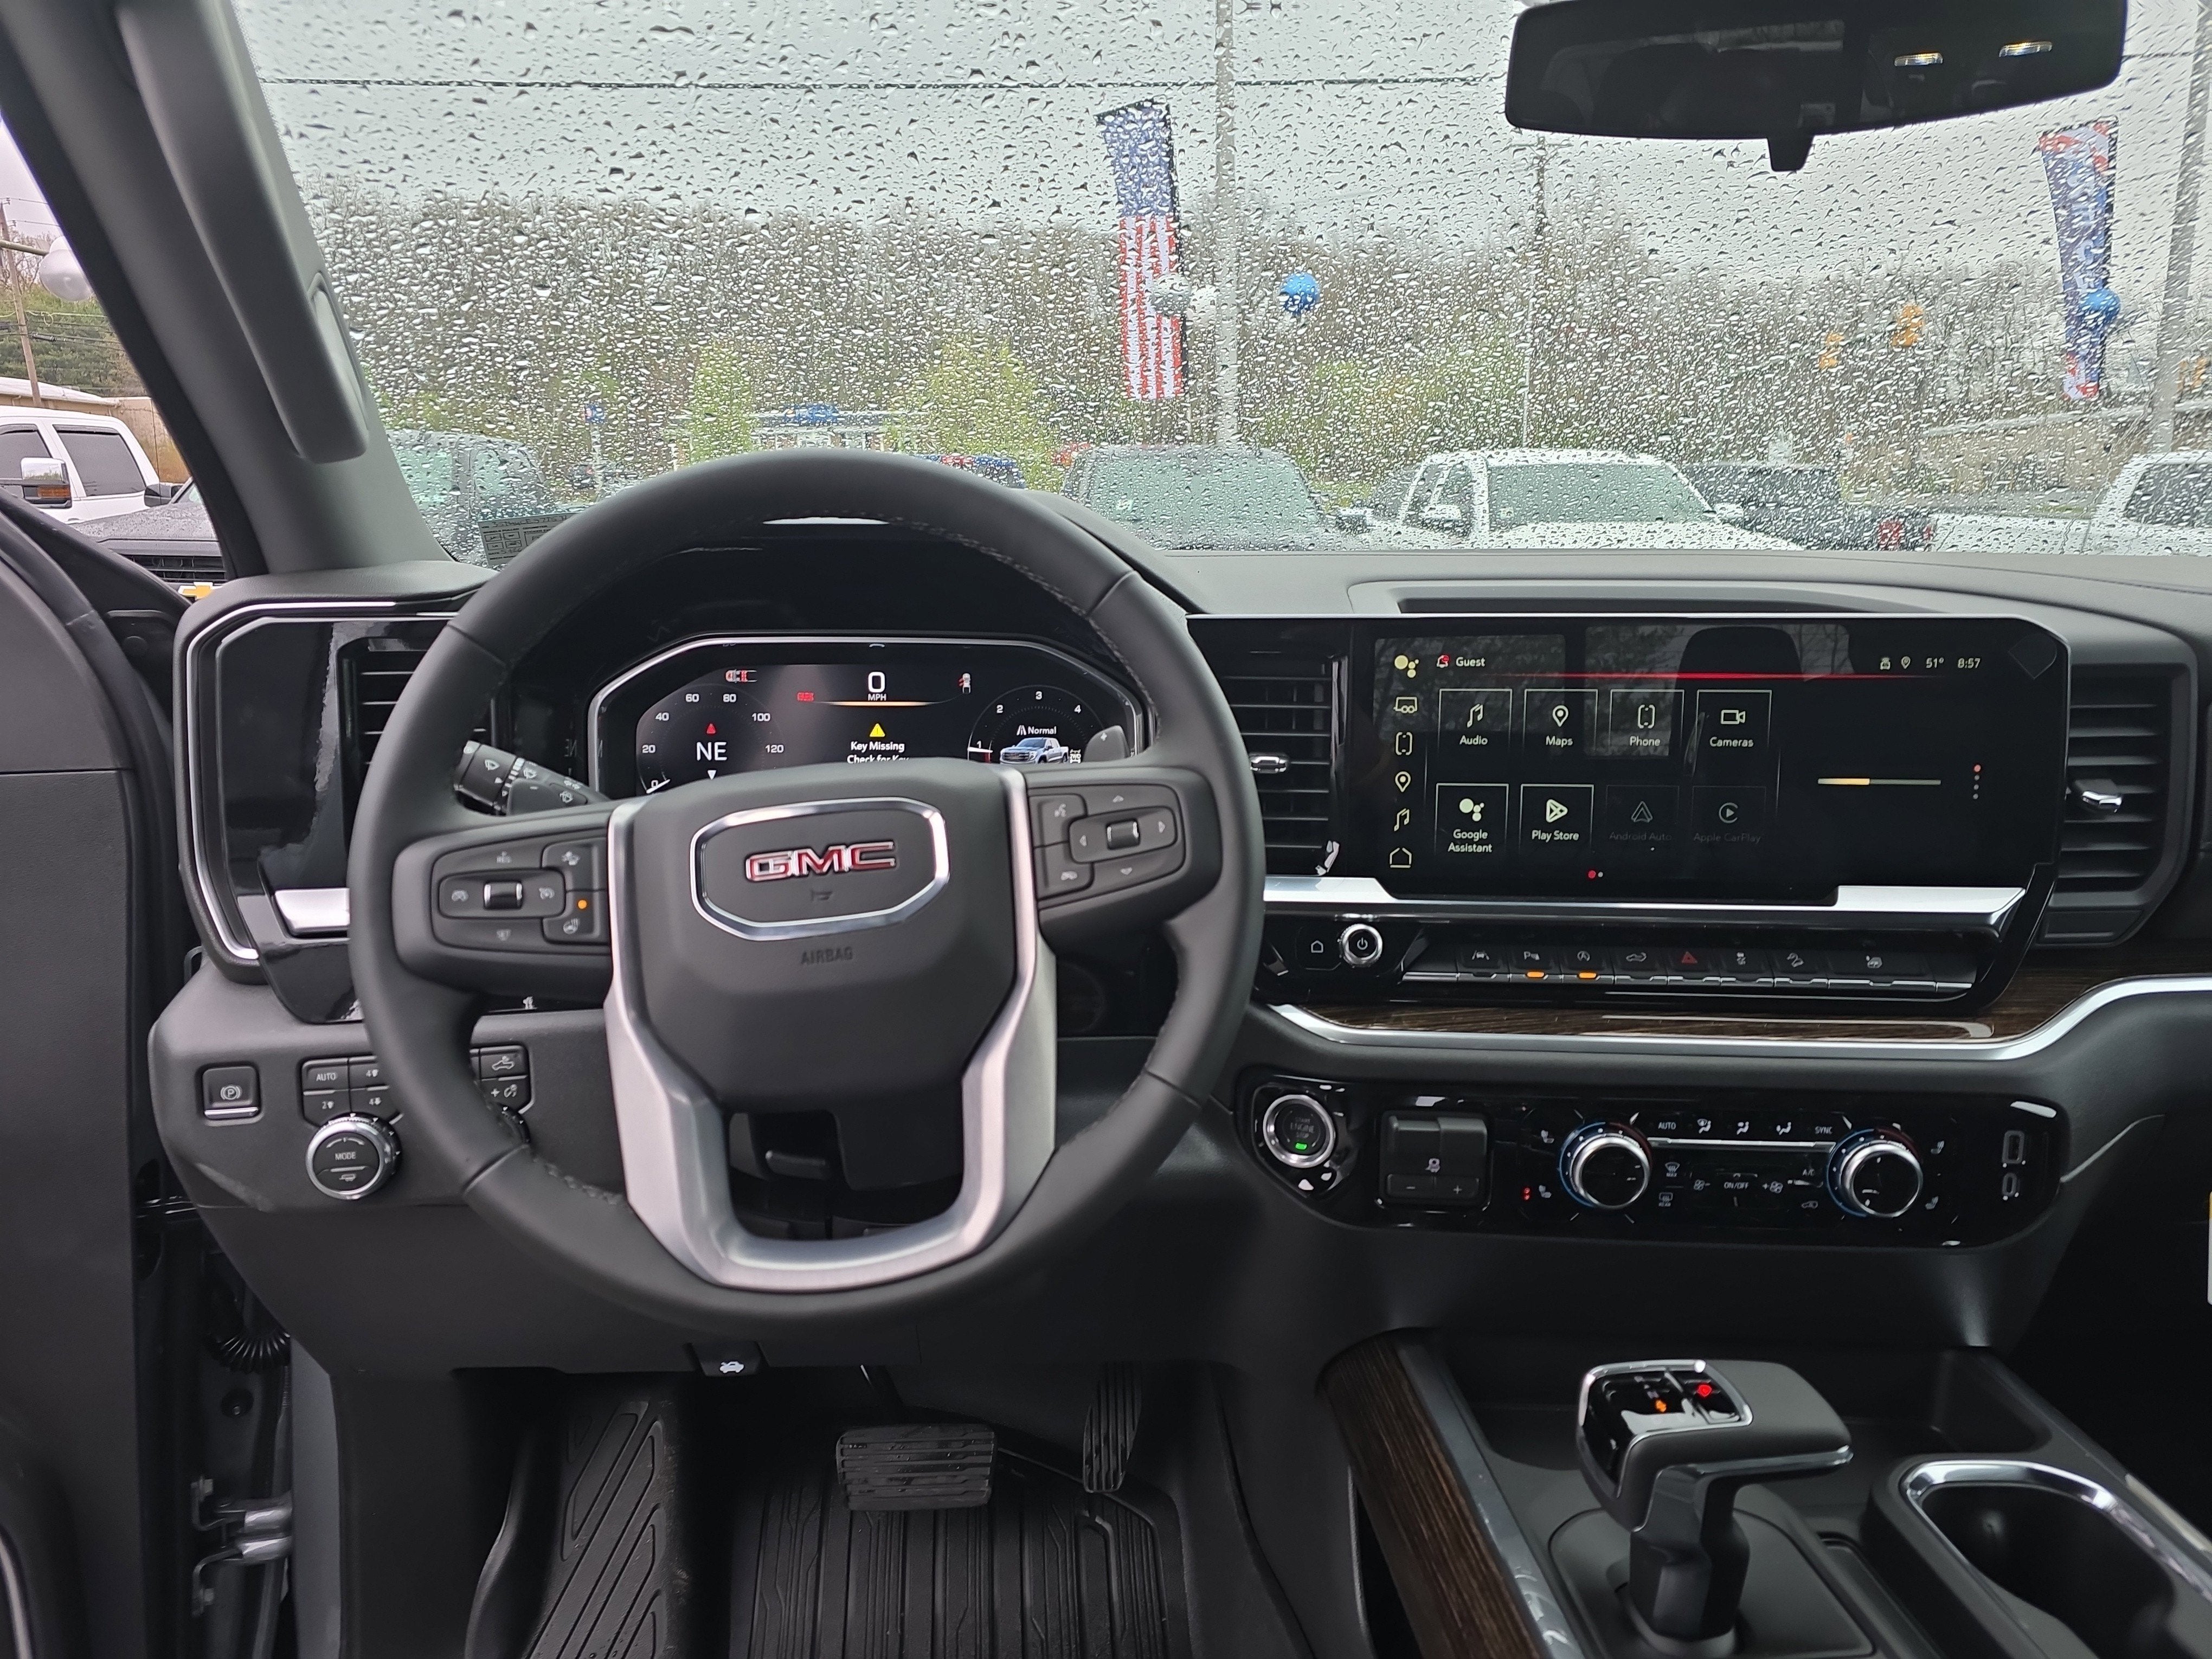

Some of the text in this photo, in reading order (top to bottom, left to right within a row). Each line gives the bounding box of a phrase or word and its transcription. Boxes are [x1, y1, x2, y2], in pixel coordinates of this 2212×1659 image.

[1456, 657, 1486, 667] Guest
[1957, 658, 1981, 668] 8:57
[867, 671, 885, 693] 0
[685, 693, 699, 703] 60
[723, 693, 737, 703] 80
[1036, 691, 1043, 700] 3
[996, 704, 1004, 713] 2
[1074, 705, 1082, 713] 4
[655, 712, 670, 721] 40
[752, 712, 771, 722] 100
[1027, 726, 1057, 735] Normal
[1459, 735, 1488, 745] Audio
[1546, 735, 1573, 748] Maps
[1630, 735, 1661, 747] Phone
[1709, 736, 1754, 747] Cameras
[642, 744, 656, 754] 20
[696, 742, 728, 761] NE
[765, 744, 784, 753] 120
[851, 741, 905, 753] Key Missing
[1453, 829, 1488, 842] Google
[1532, 830, 1580, 843] Play Store
[1609, 831, 1672, 840] Android Auto
[1693, 832, 1760, 844] Apple CarPlay
[1448, 842, 1493, 853] Assistant
[746, 841, 896, 882] GMC
[800, 947, 854, 965] AIRBAG
[316, 1072, 337, 1082] AUTO
[366, 1069, 372, 1077] 4
[227, 1088, 235, 1098] P
[322, 1101, 327, 1109] 2
[1658, 1121, 1676, 1130] AUTO
[1815, 1126, 1833, 1134] SYNC
[335, 1152, 356, 1160] MODE
[1724, 1181, 1749, 1189] ON/OFF
